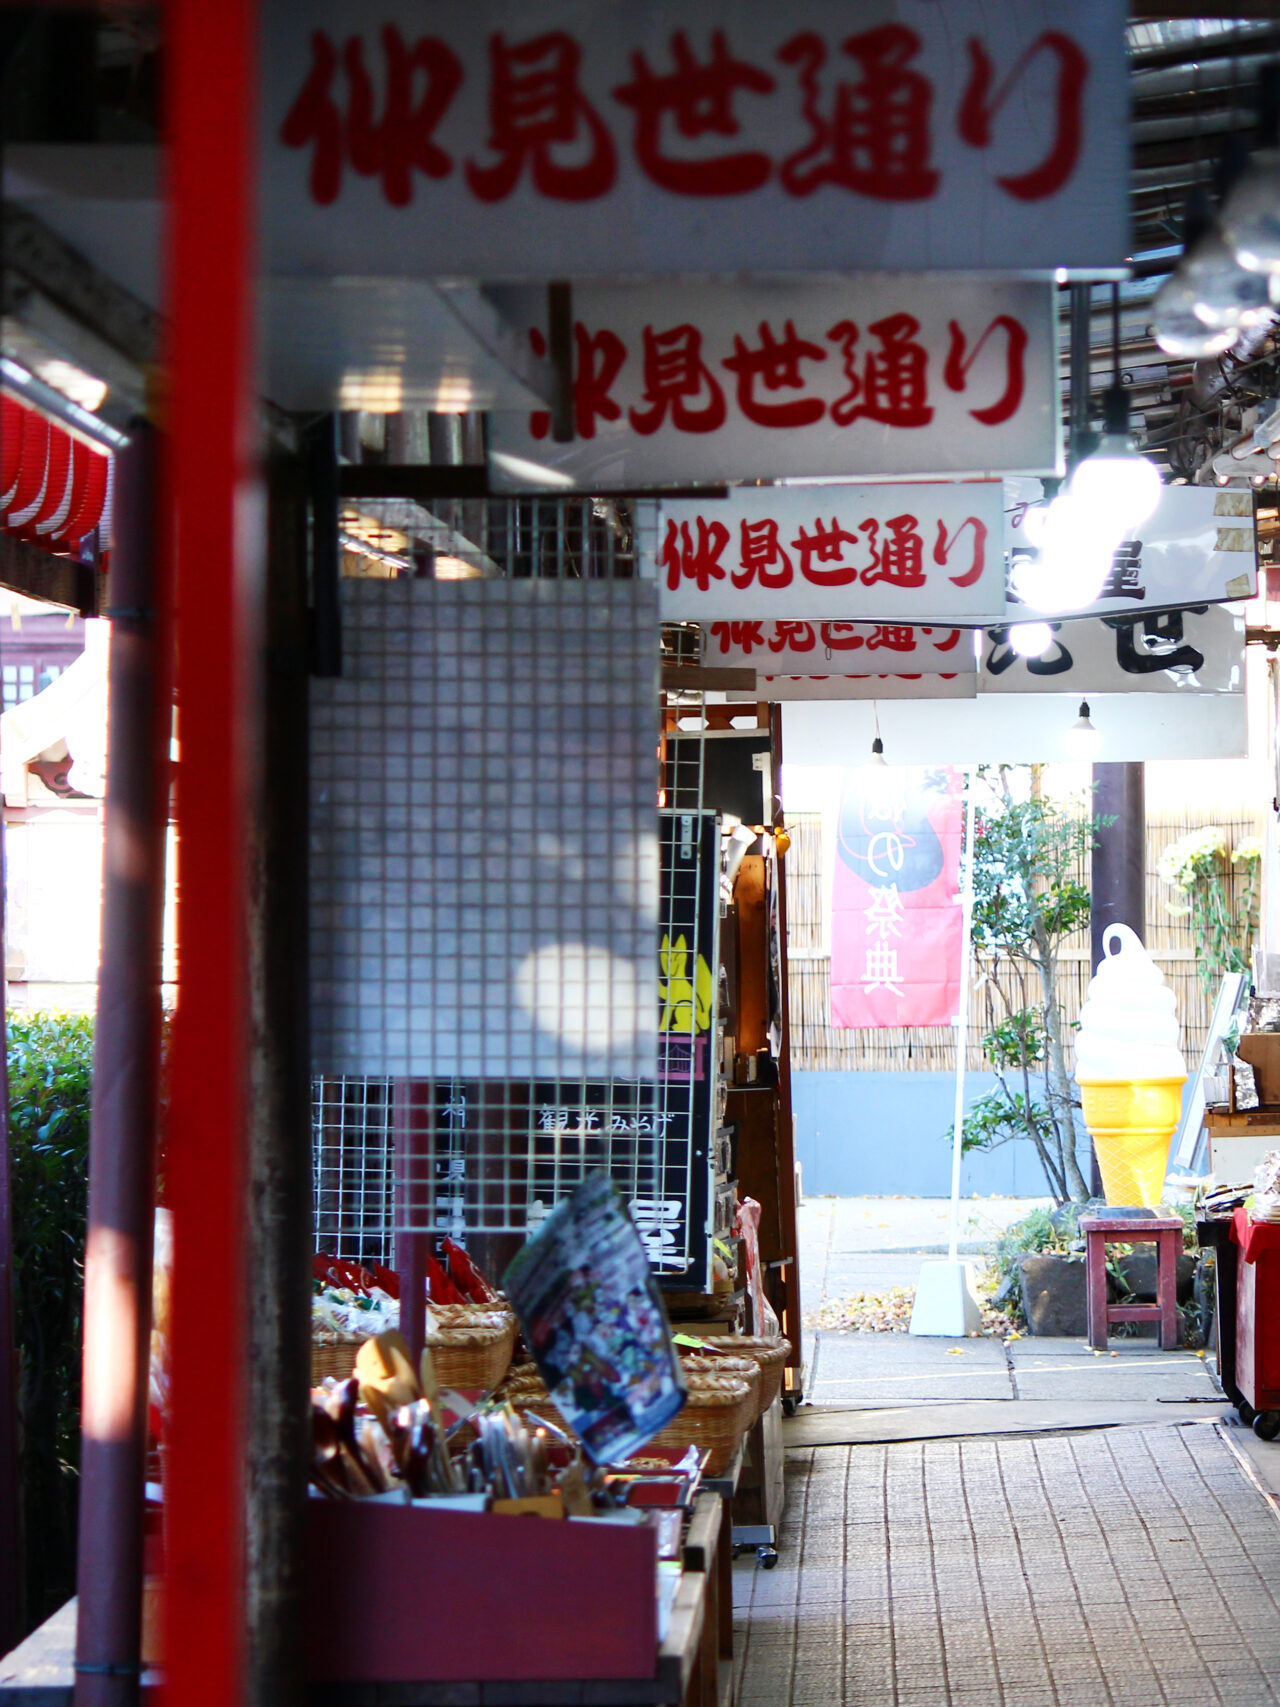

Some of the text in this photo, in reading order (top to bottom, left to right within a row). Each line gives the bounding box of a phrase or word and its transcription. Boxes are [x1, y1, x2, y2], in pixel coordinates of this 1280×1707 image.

[280, 22, 1090, 208] 仲見世通り
[657, 514, 988, 592] 仲見世通り
